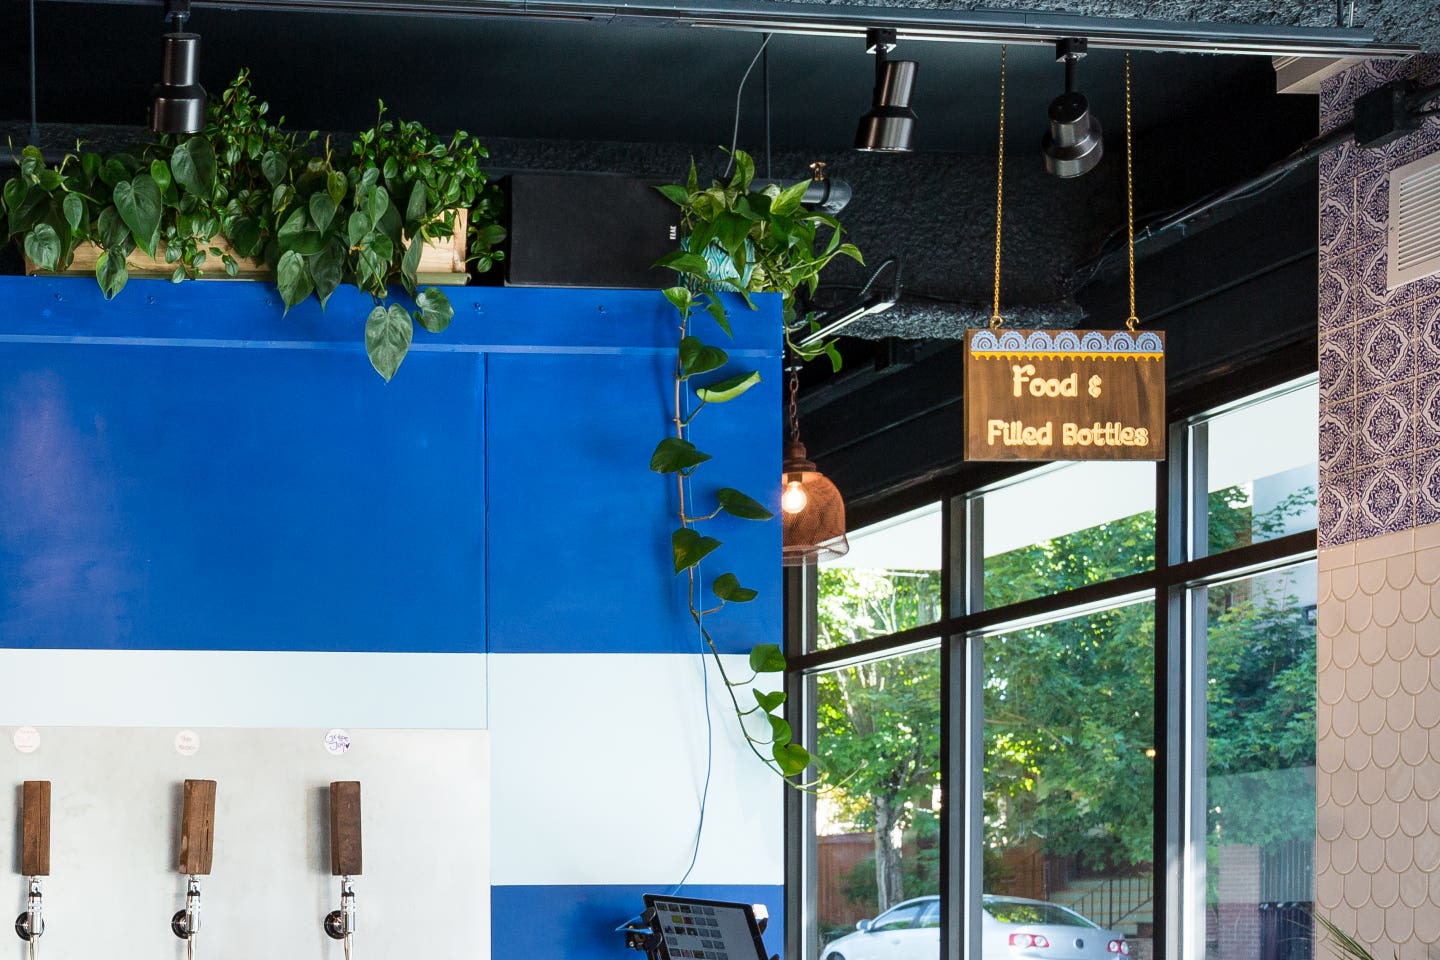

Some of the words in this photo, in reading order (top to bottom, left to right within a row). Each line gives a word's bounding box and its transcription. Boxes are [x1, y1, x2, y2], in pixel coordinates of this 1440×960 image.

[1012, 364, 1078, 398] Food
[1088, 374, 1102, 398] &
[987, 419, 1052, 446] Filled
[1062, 421, 1149, 447] Bottles
